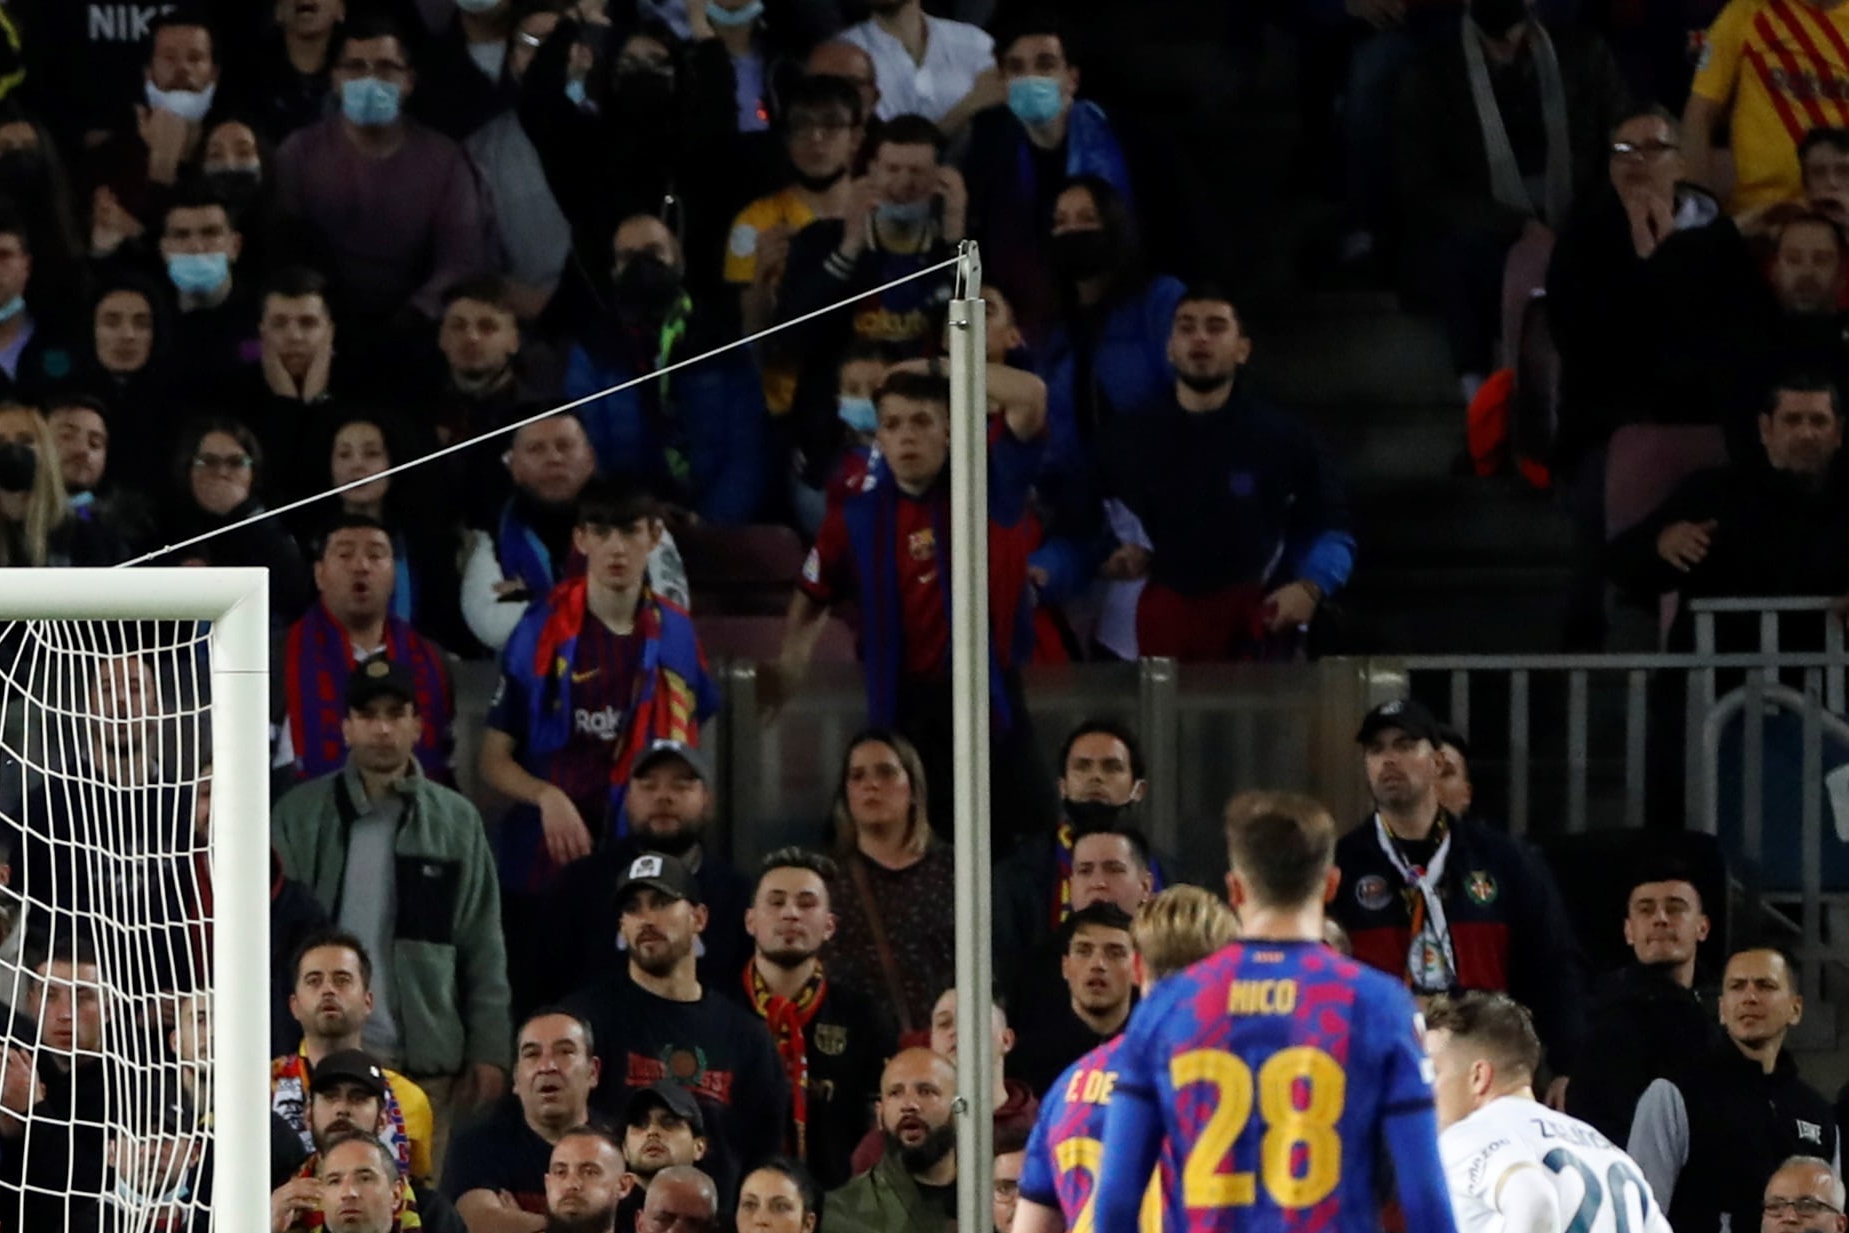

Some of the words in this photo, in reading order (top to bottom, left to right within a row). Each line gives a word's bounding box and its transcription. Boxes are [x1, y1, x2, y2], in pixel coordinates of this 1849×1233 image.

[88, 4, 176, 42] NIK
[1229, 980, 1297, 1015] NICO
[1169, 1046, 1347, 1209] 28
